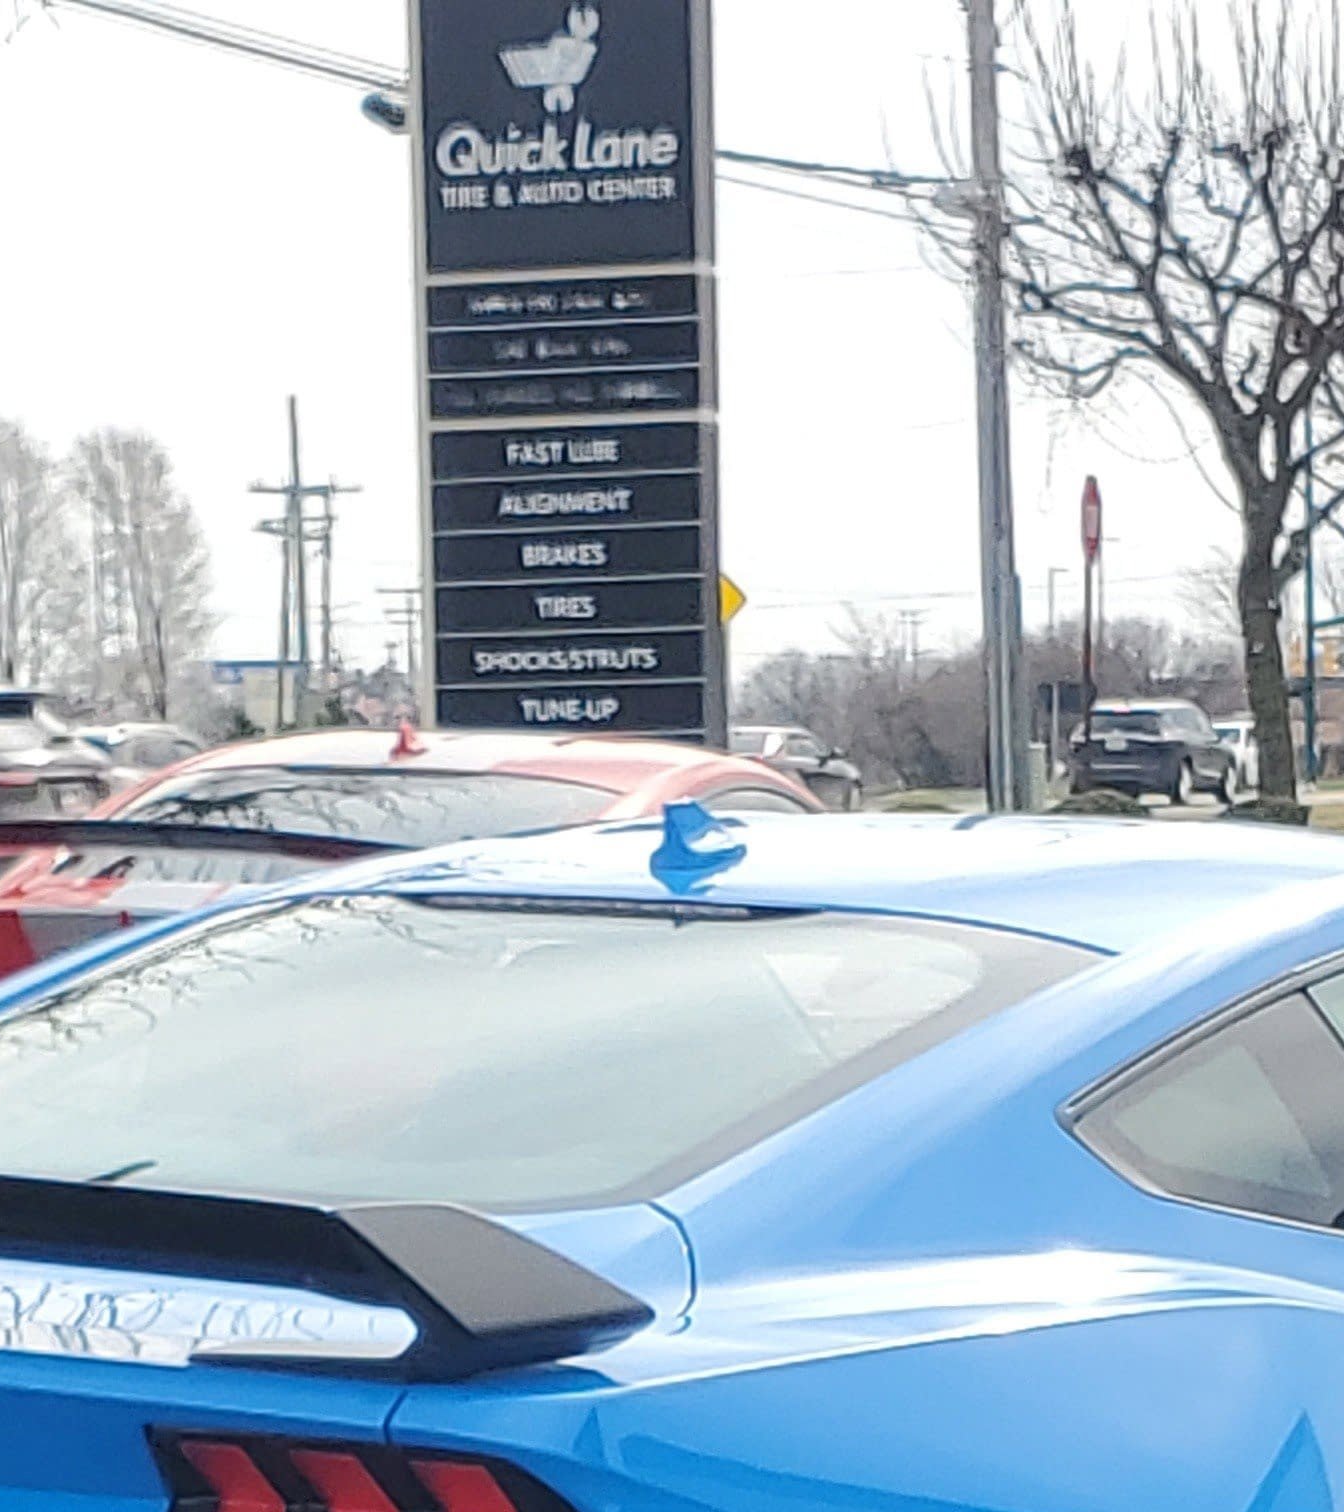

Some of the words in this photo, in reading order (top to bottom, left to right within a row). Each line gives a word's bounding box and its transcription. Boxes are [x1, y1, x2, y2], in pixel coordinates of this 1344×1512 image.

[436, 119, 567, 176] Quick
[574, 115, 678, 169] Lane
[519, 181, 583, 204] AUTO
[587, 177, 675, 202] CENTER
[506, 441, 562, 465] FAST
[499, 488, 631, 516] ALIGNMENT
[522, 544, 607, 567] BRAKES
[536, 596, 597, 618] TIRES
